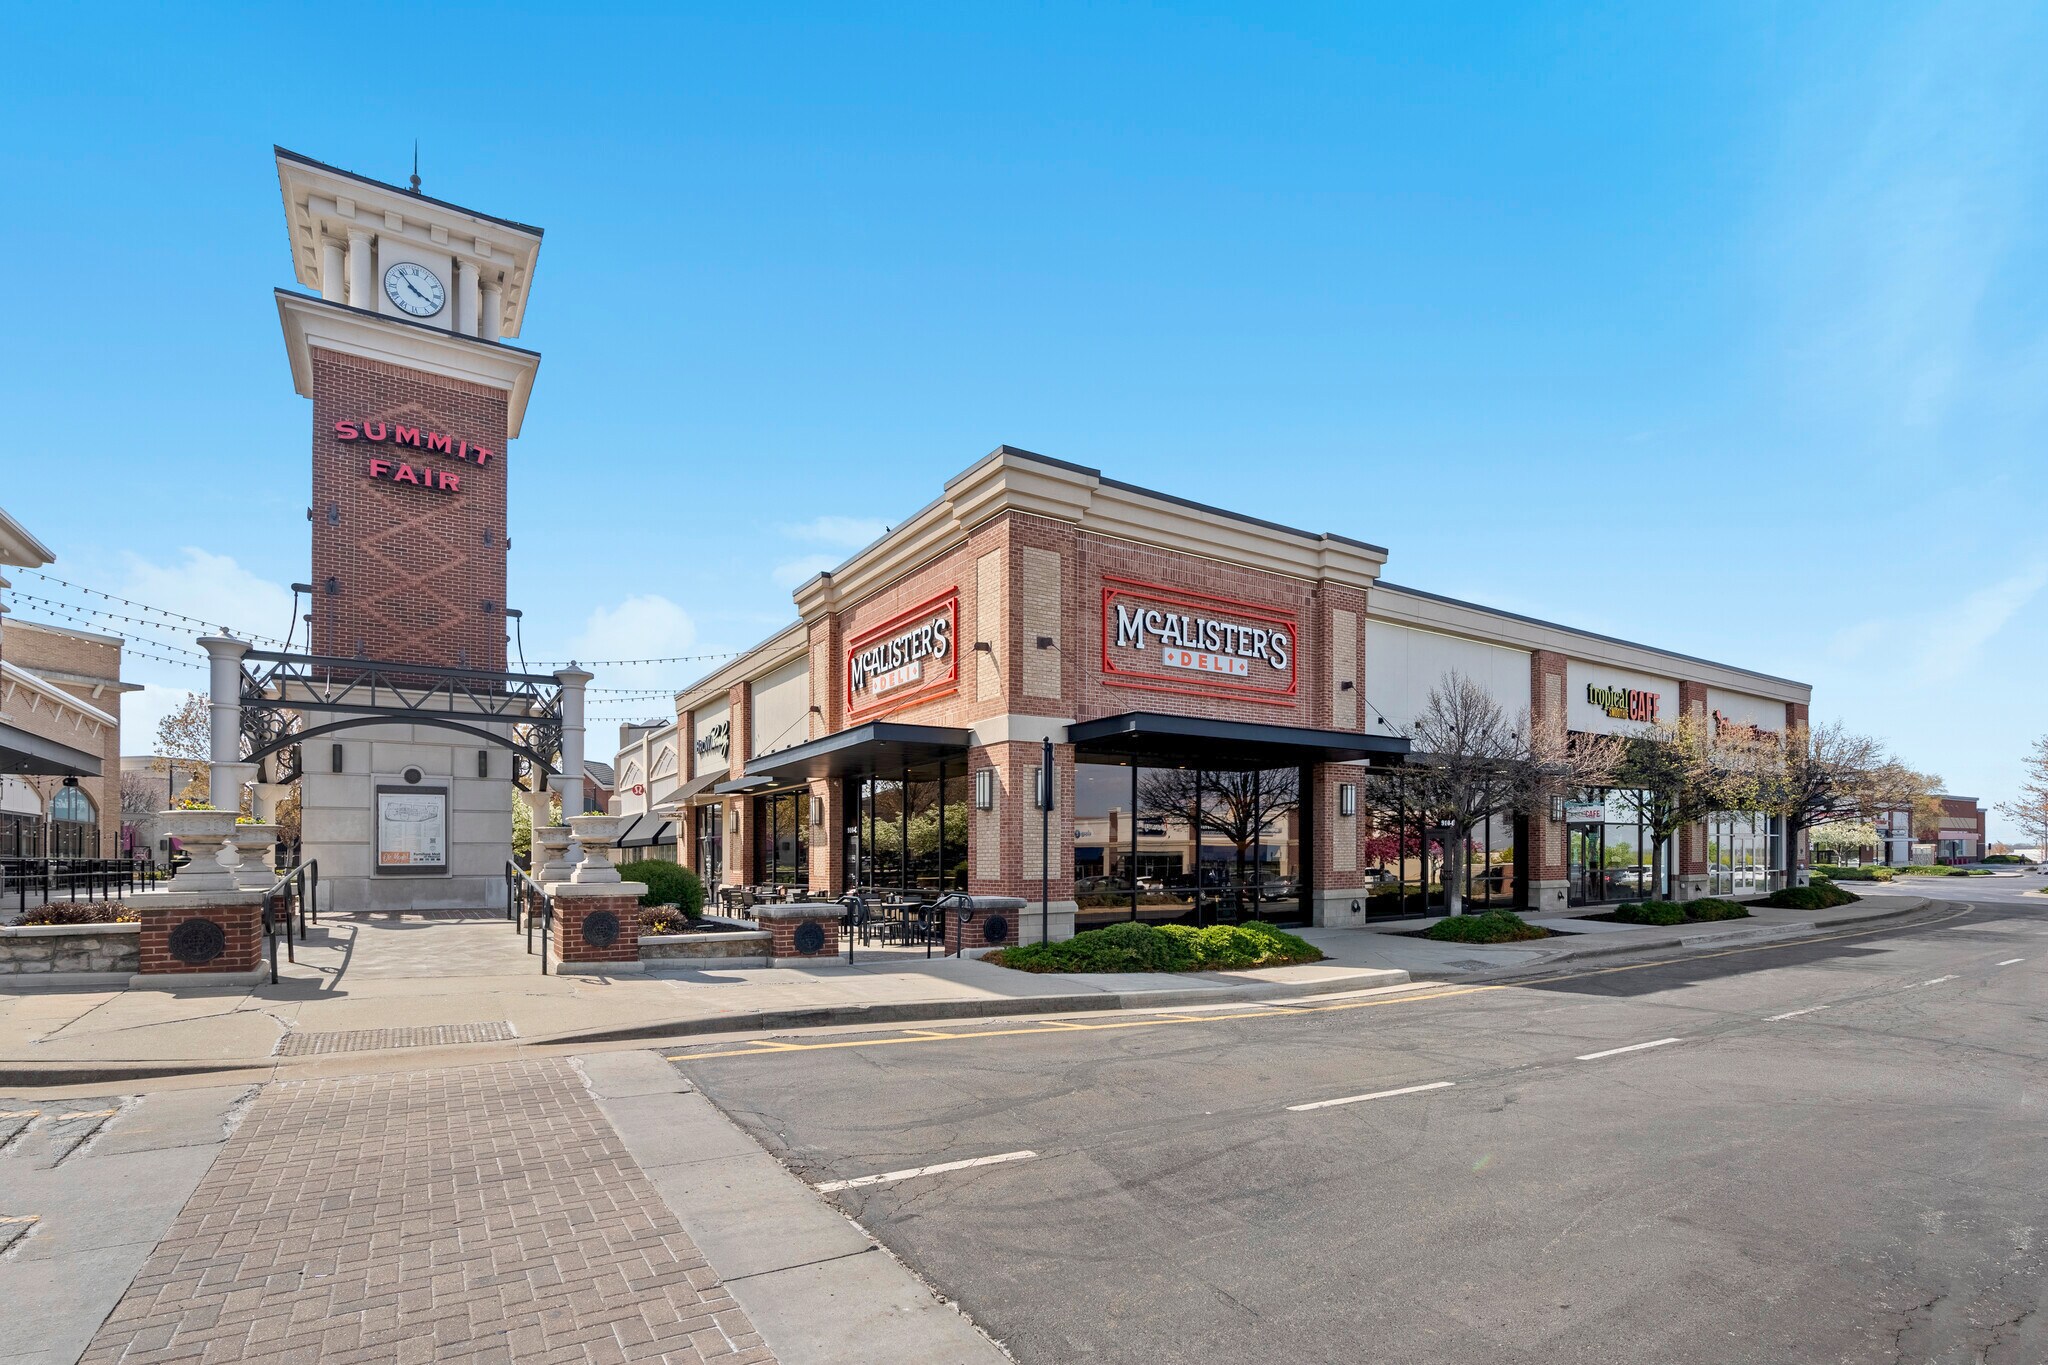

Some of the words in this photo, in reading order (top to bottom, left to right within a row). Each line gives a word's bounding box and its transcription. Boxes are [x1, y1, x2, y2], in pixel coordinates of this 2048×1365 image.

[335, 420, 494, 465] SUMMIT
[369, 458, 460, 492] FAIR
[880, 667, 910, 689] DELI
[1180, 651, 1234, 673] DELI
[1587, 683, 1629, 710] tropical
[1629, 689, 1660, 722] CAFE
